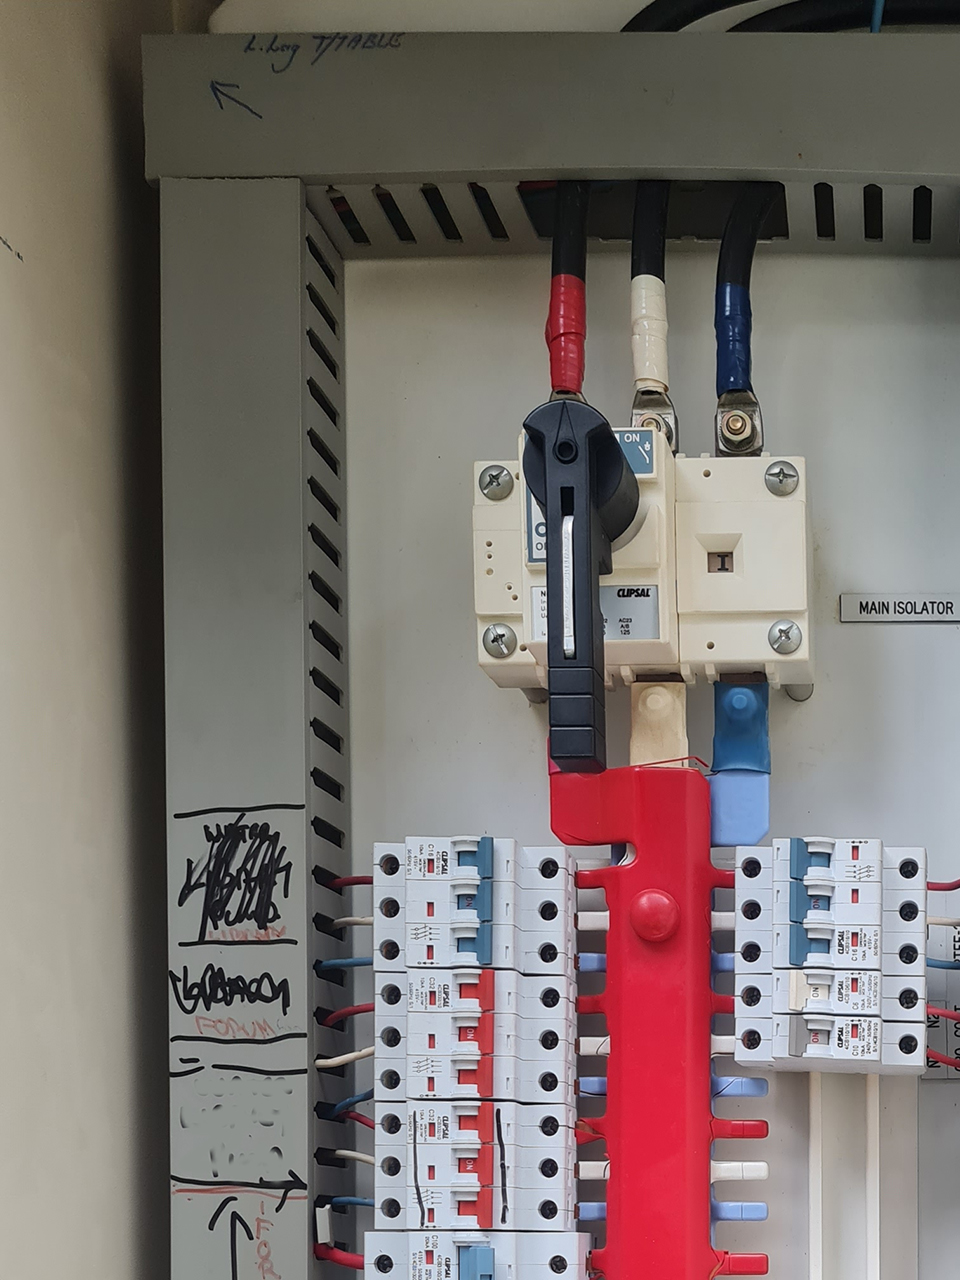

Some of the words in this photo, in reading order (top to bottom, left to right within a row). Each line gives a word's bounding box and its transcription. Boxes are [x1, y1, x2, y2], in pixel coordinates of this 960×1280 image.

[624, 434, 640, 442] ON
[617, 588, 650, 598] CLIPSAL
[859, 601, 890, 616] MAIN
[893, 601, 955, 616] ISOLATOR
